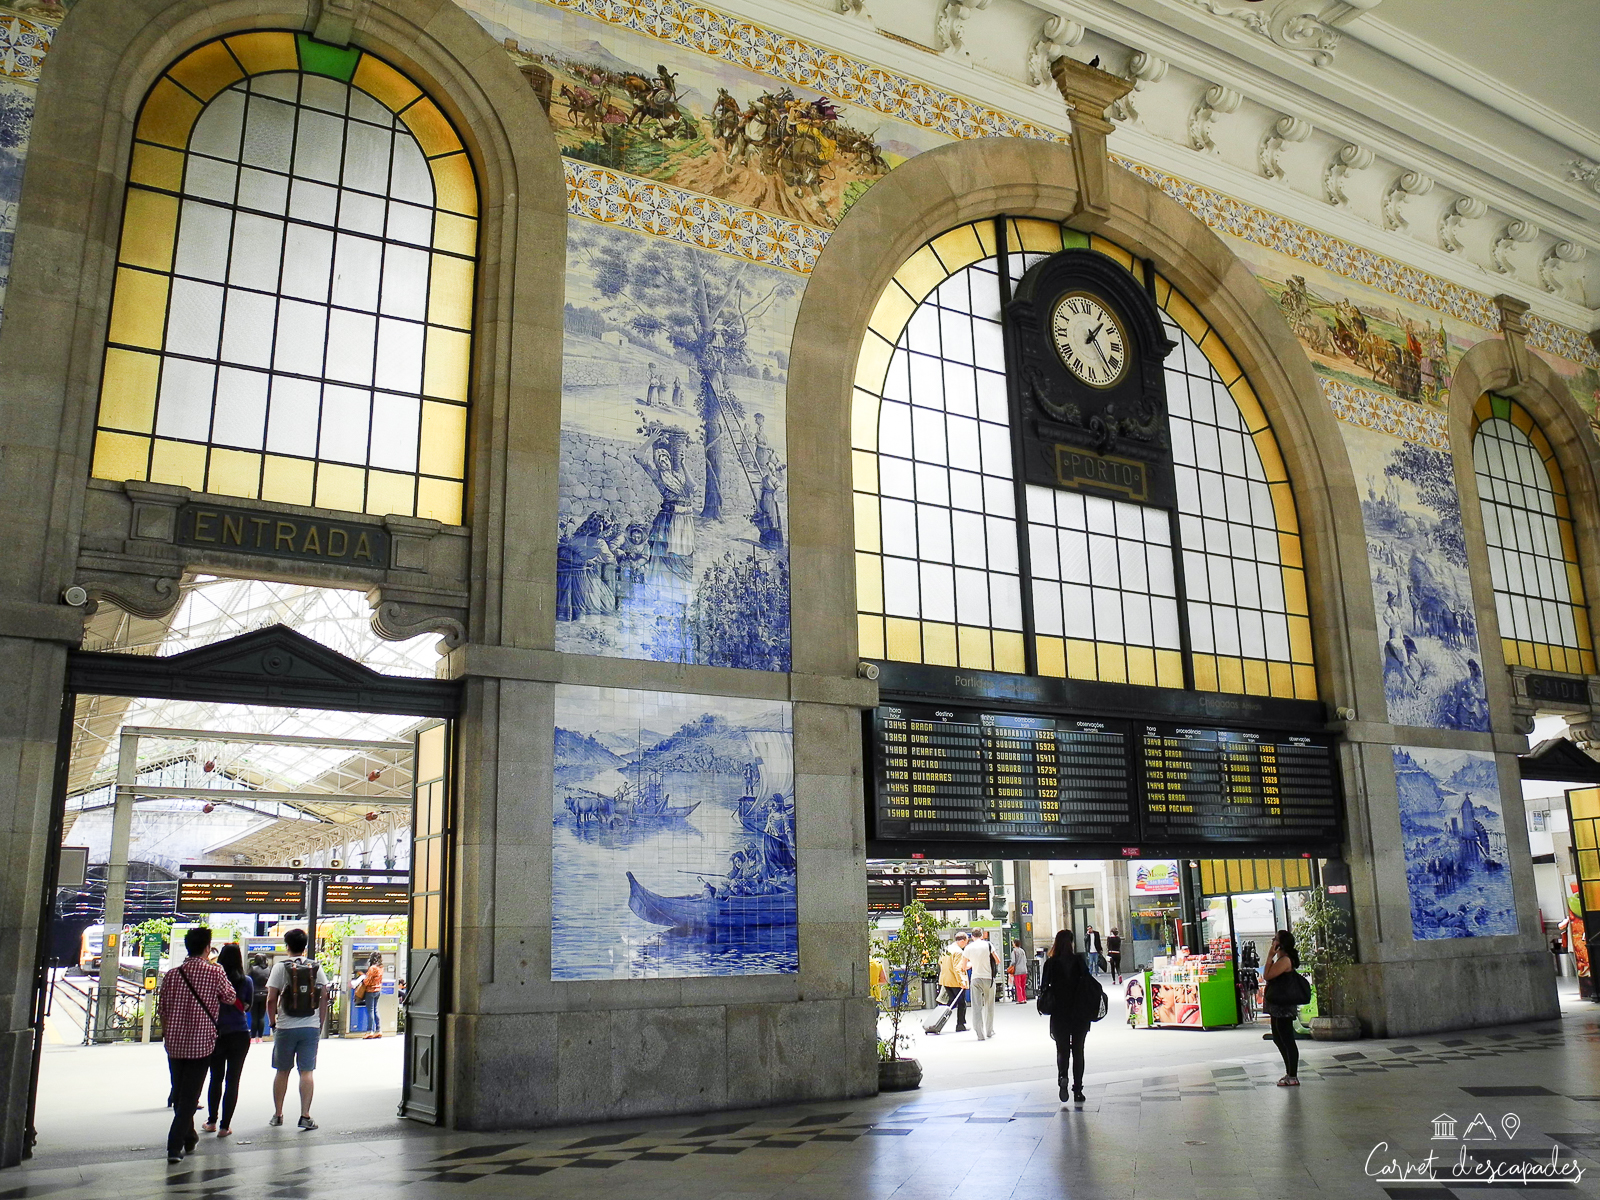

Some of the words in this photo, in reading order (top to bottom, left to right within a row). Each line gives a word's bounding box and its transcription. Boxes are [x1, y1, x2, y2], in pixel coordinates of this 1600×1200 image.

[1068, 302, 1079, 315] XI
[1081, 302, 1091, 315] XII
[1059, 312, 1070, 324] X
[1097, 312, 1103, 321] I
[1058, 325, 1067, 337] IX
[1106, 327, 1115, 335] II
[1061, 343, 1073, 360] VIII
[1110, 342, 1120, 352] III
[1073, 357, 1083, 373] VII
[1108, 355, 1119, 370] IIII
[1088, 366, 1096, 379] VI
[1071, 454, 1132, 485] PORTO
[194, 512, 373, 562] ENTRADA
[955, 676, 995, 689] Partidas
[1534, 679, 1580, 699] SAIDA
[884, 720, 906, 729] 13H45
[911, 722, 932, 731] BRAGA
[1035, 731, 1054, 739] 15225
[911, 735, 928, 743] OVAR
[912, 747, 946, 757] PENAFIEL
[996, 752, 1020, 760] SUBURB
[1036, 754, 1055, 762] 15411
[886, 758, 908, 767] 14H05
[912, 760, 939, 769] AVEIRO
[997, 764, 1021, 772] SUBURB
[1037, 766, 1056, 774] 15734
[886, 771, 908, 779] 14H20
[913, 772, 952, 781] GUIMARAES
[998, 776, 1022, 784] SUBURB
[1038, 778, 1057, 786] 15163
[886, 784, 908, 792] 14H45
[913, 784, 935, 793] BRAGA
[1038, 789, 1057, 797] 15227
[887, 809, 910, 817] 15H00
[914, 810, 936, 818] CAIDE
[1040, 813, 1058, 821] 15531
